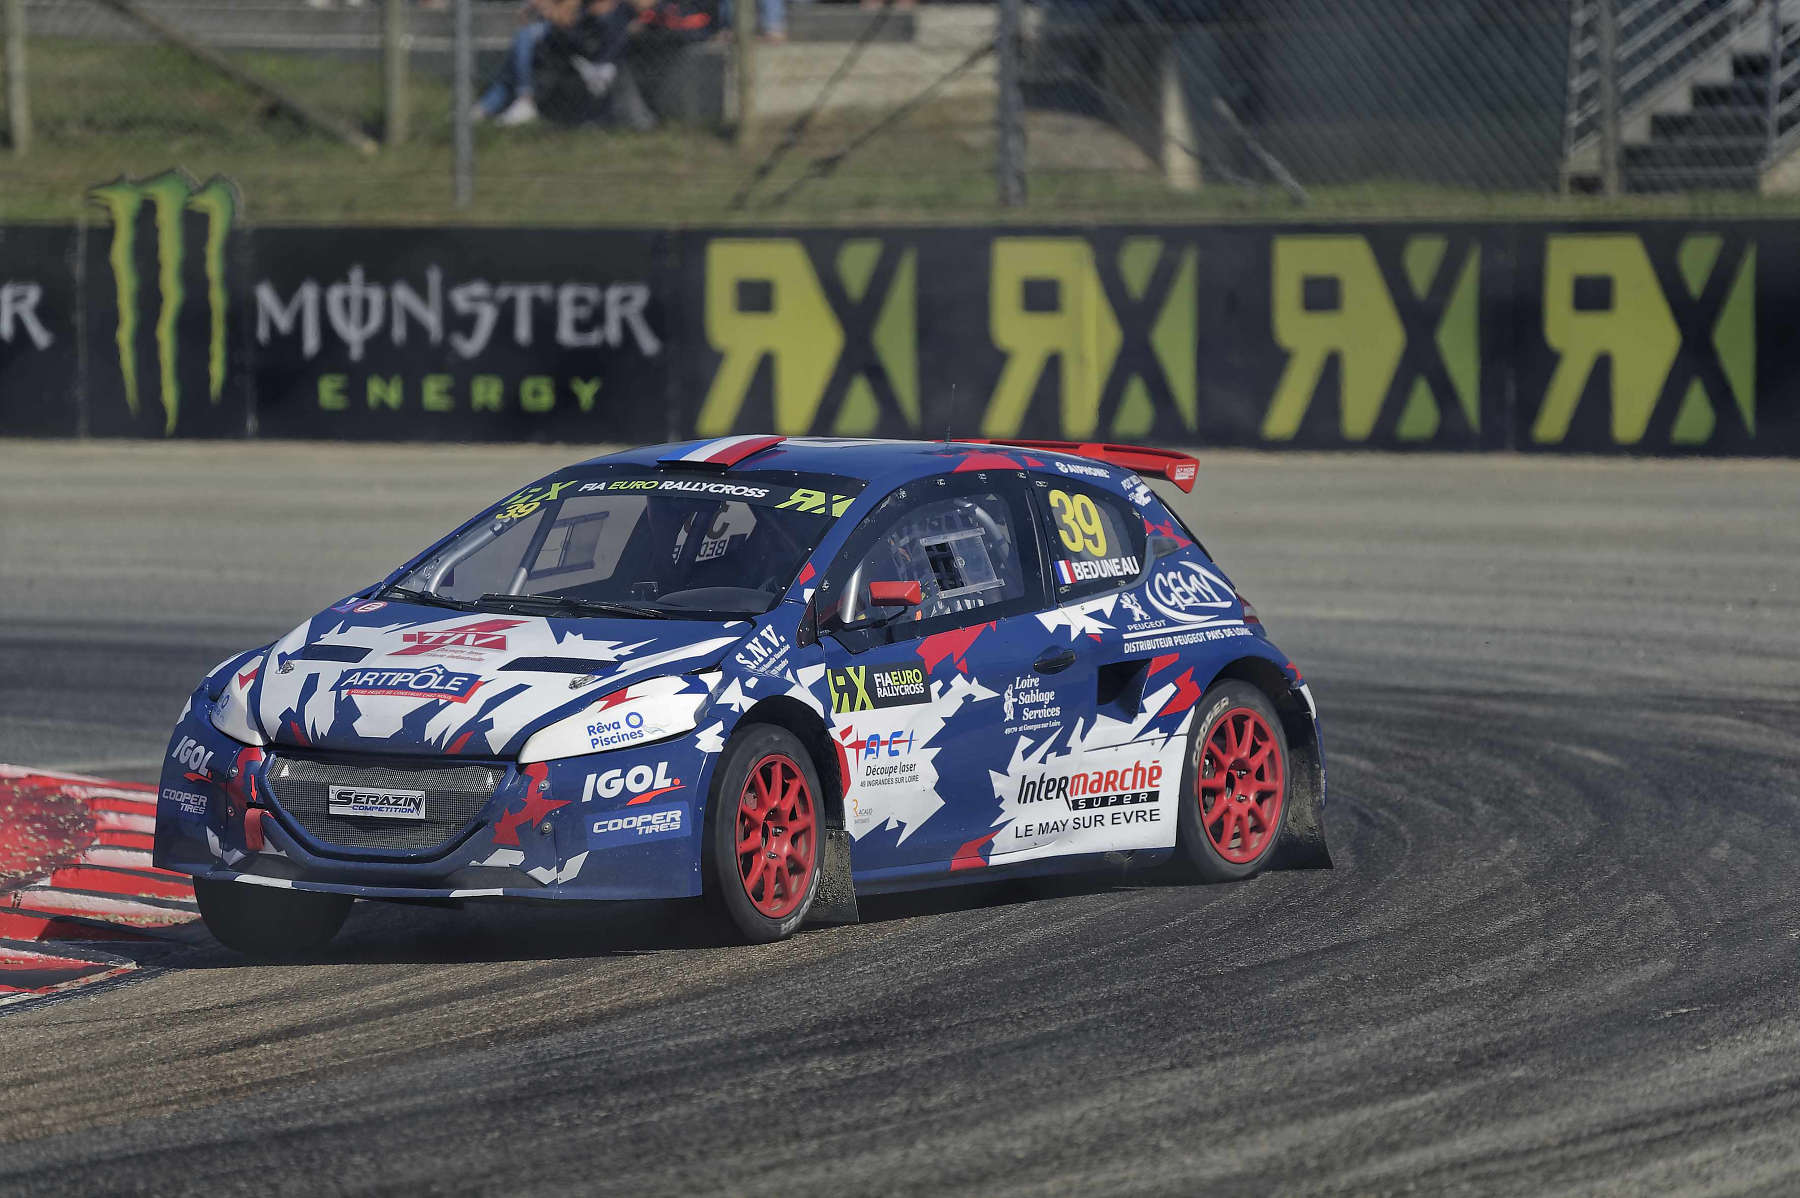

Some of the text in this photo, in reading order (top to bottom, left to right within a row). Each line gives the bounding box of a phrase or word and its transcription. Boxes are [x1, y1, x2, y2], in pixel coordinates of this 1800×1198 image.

[255, 263, 662, 360] MONSTER
[318, 373, 602, 411] ENERGY
[578, 480, 770, 498] FIA EURO RALLYCROSS
[495, 501, 541, 520] 39
[1048, 489, 1107, 557] 39
[1070, 556, 1140, 581] BEDUNEAU
[1154, 571, 1224, 611] GEMY
[1127, 619, 1167, 631] PEUGEOT
[1124, 640, 1174, 654] DISTRIBUTEUR
[1174, 633, 1207, 646] PEUGEOT
[1205, 629, 1225, 641] PAYS
[1223, 627, 1234, 638] DE
[341, 665, 468, 691] ARTIPÔLE
[1015, 674, 1040, 689] Loire
[877, 683, 925, 698] RALLYCROSS
[1019, 689, 1055, 704] Sablage
[1022, 705, 1061, 721] Services
[587, 721, 621, 737] Rêva
[1192, 695, 1230, 767] COOPER
[590, 730, 644, 749] Piscines
[866, 761, 916, 776] Découpe laser
[867, 777, 894, 787] INGRANDES
[895, 776, 905, 784] SUR
[905, 774, 919, 783] LOIRE
[162, 788, 208, 807] COOPER
[333, 789, 424, 815] SERAZIN
[179, 802, 206, 815] TIRES
[352, 805, 415, 813] COMPETITION
[592, 809, 682, 833] COOPER
[636, 821, 681, 835] TIRES
[1015, 809, 1161, 839] LE MAY SUR EVRE
